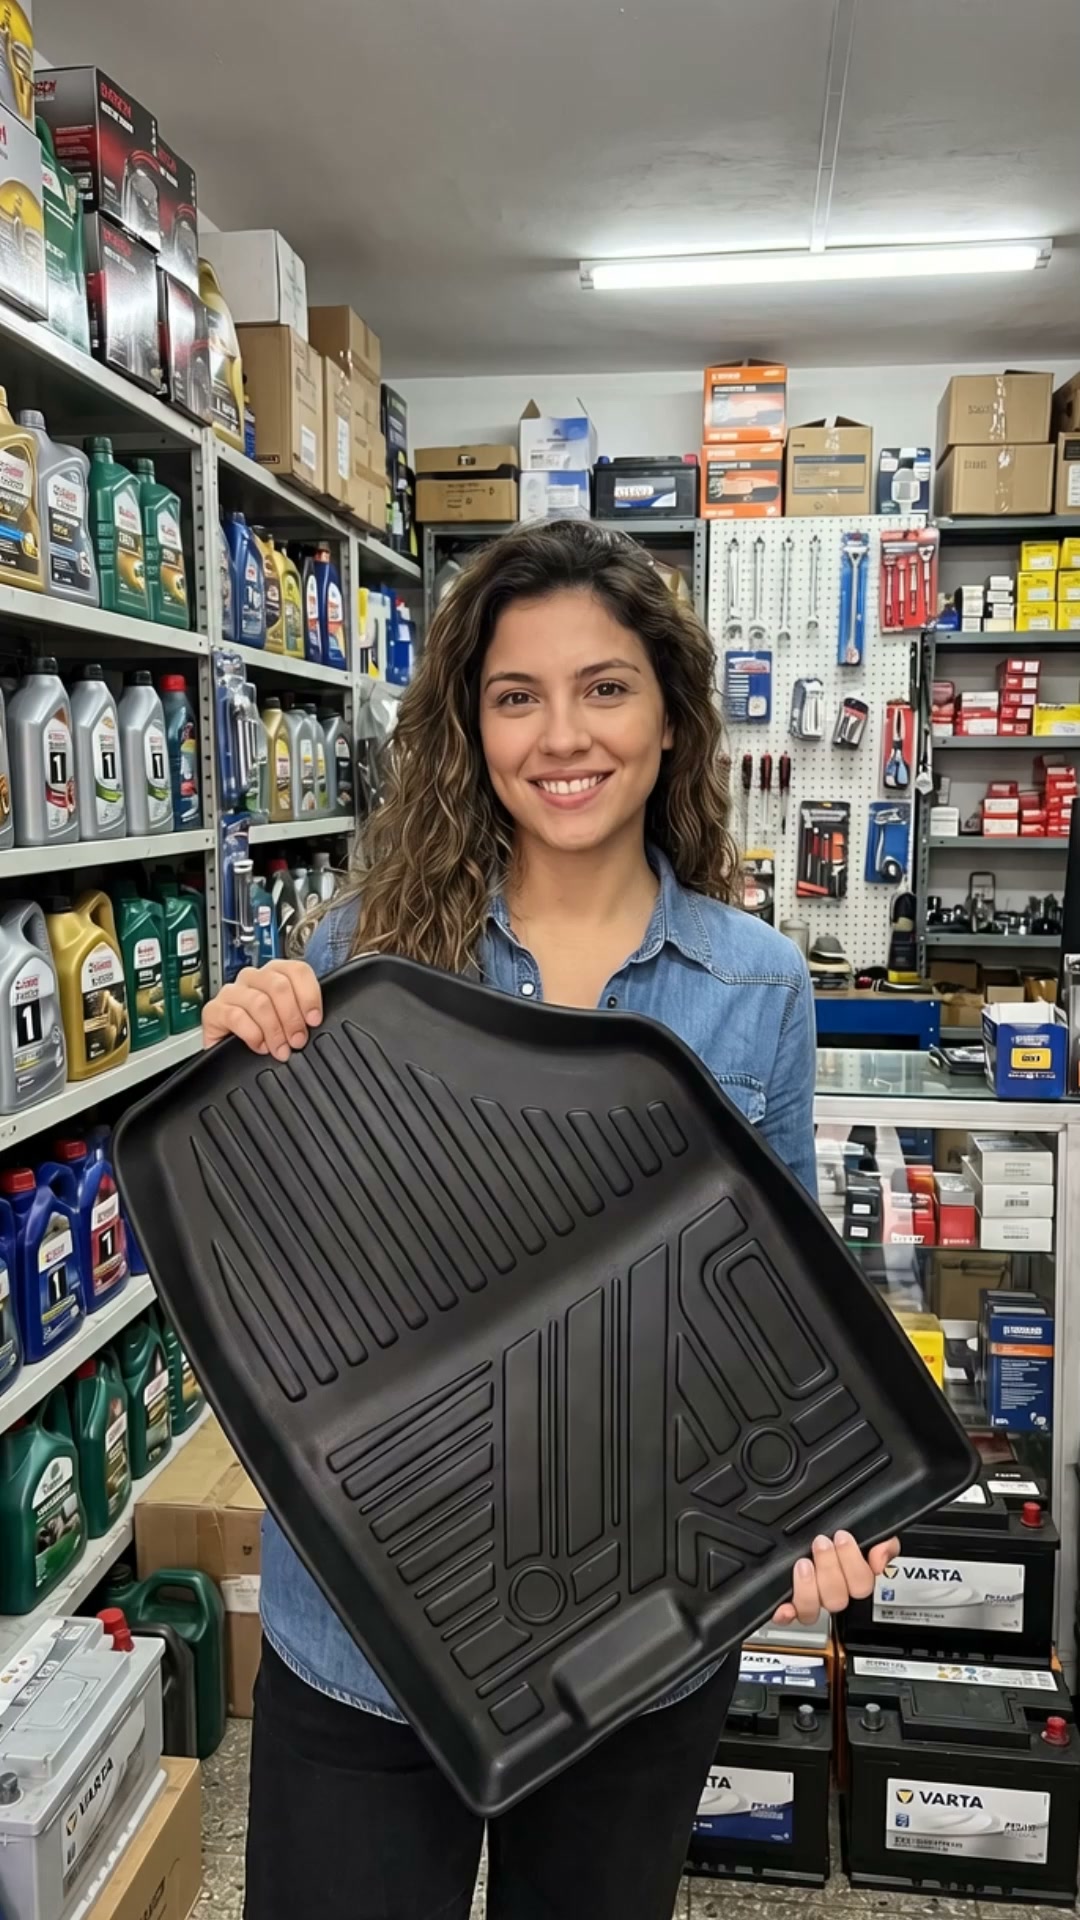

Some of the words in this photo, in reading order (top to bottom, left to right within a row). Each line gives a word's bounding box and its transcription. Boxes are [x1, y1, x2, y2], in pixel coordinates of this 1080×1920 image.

[22, 1005, 35, 1041] 1
[52, 1271, 61, 1300] 1
[903, 1566, 963, 1582] VARTA
[919, 1790, 984, 1809] VARTA
